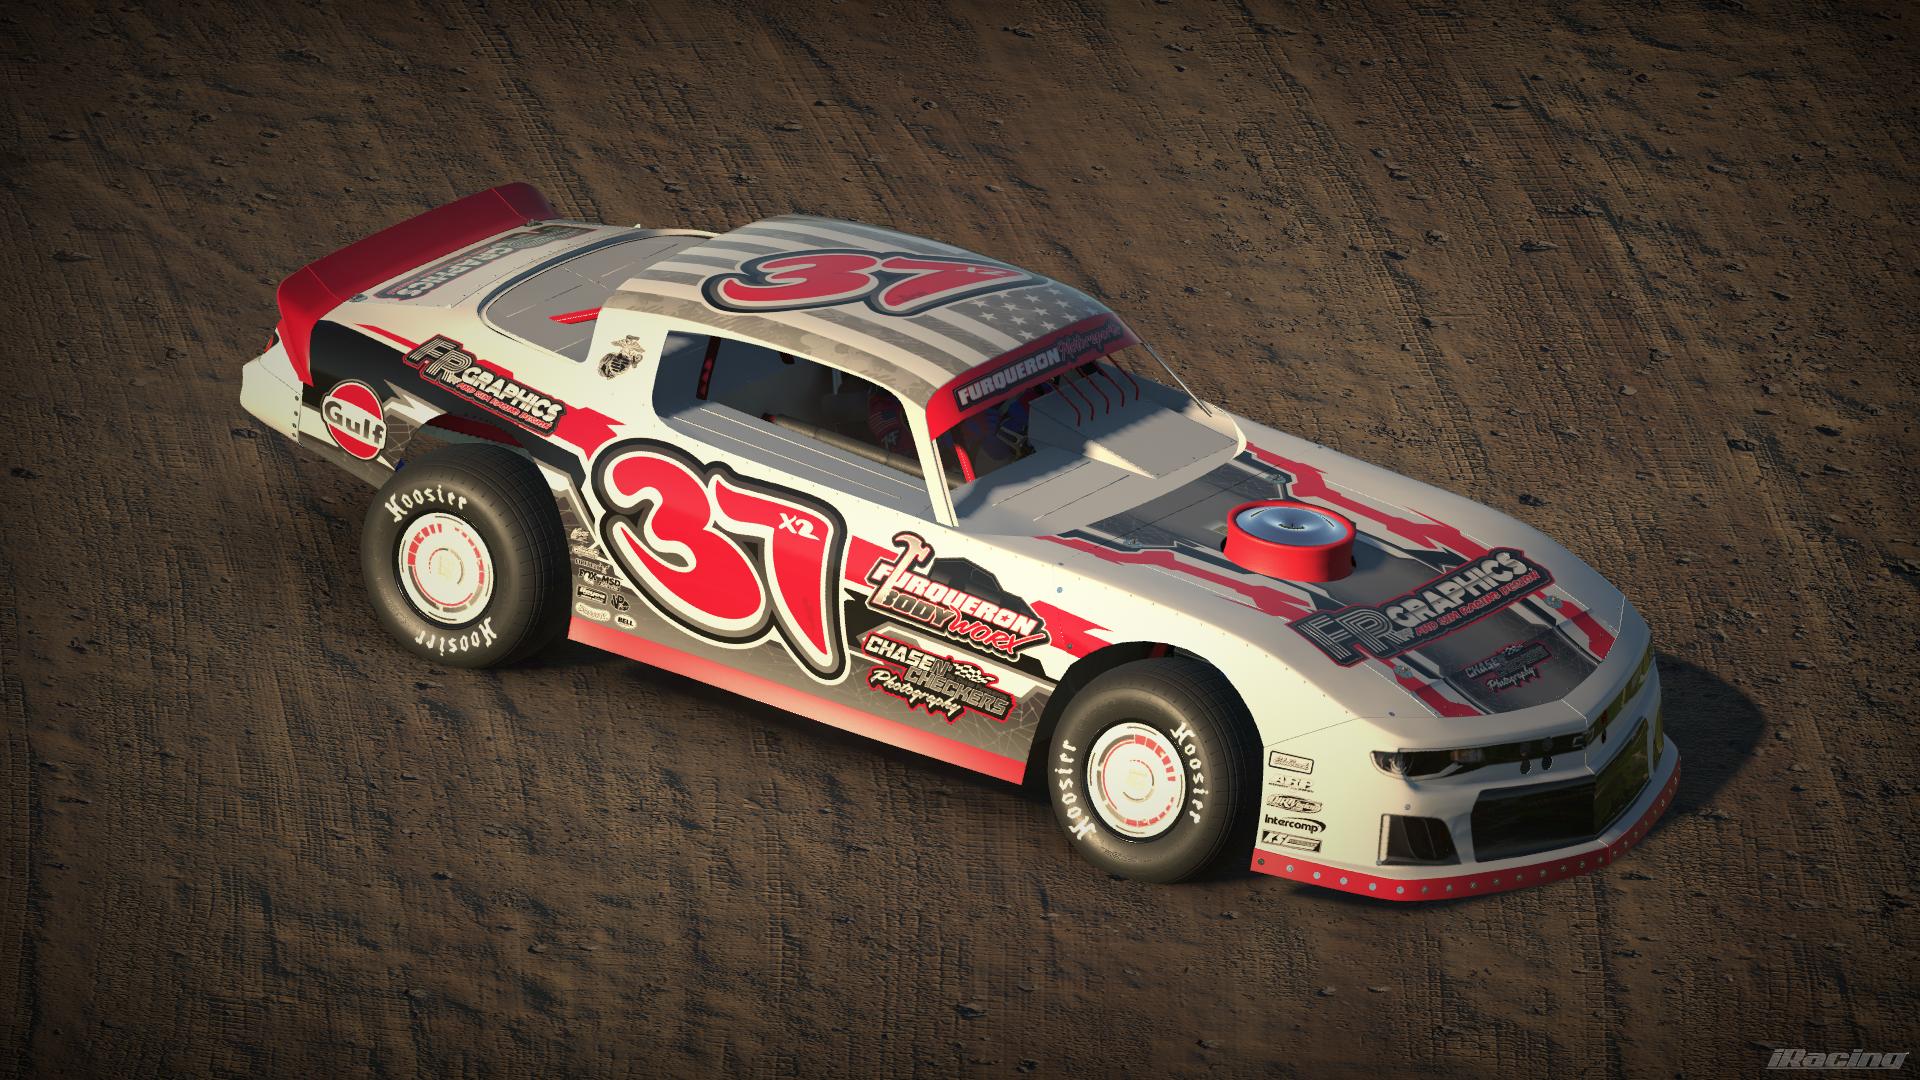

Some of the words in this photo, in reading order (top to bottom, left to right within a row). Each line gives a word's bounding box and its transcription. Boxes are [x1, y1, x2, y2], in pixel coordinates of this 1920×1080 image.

[716, 252, 1034, 310] 37
[461, 366, 563, 422] GRAPHICS
[957, 347, 1061, 406] FURQUERON
[325, 401, 384, 444] Gulf
[385, 484, 467, 523] Hoosier
[778, 512, 821, 541] X2
[604, 451, 834, 667] 37
[871, 563, 1040, 636] FURQUERON
[1386, 552, 1527, 628] GRAPHICS
[415, 616, 498, 656] Hoosier
[617, 616, 634, 627] BELL
[865, 635, 933, 671] CHASE
[870, 669, 963, 717] Photography
[904, 665, 1010, 717] CHECKERS
[1054, 739, 1097, 841] Hoosier
[1170, 721, 1209, 824] Hoosier
[1265, 814, 1319, 834] Intercomp
